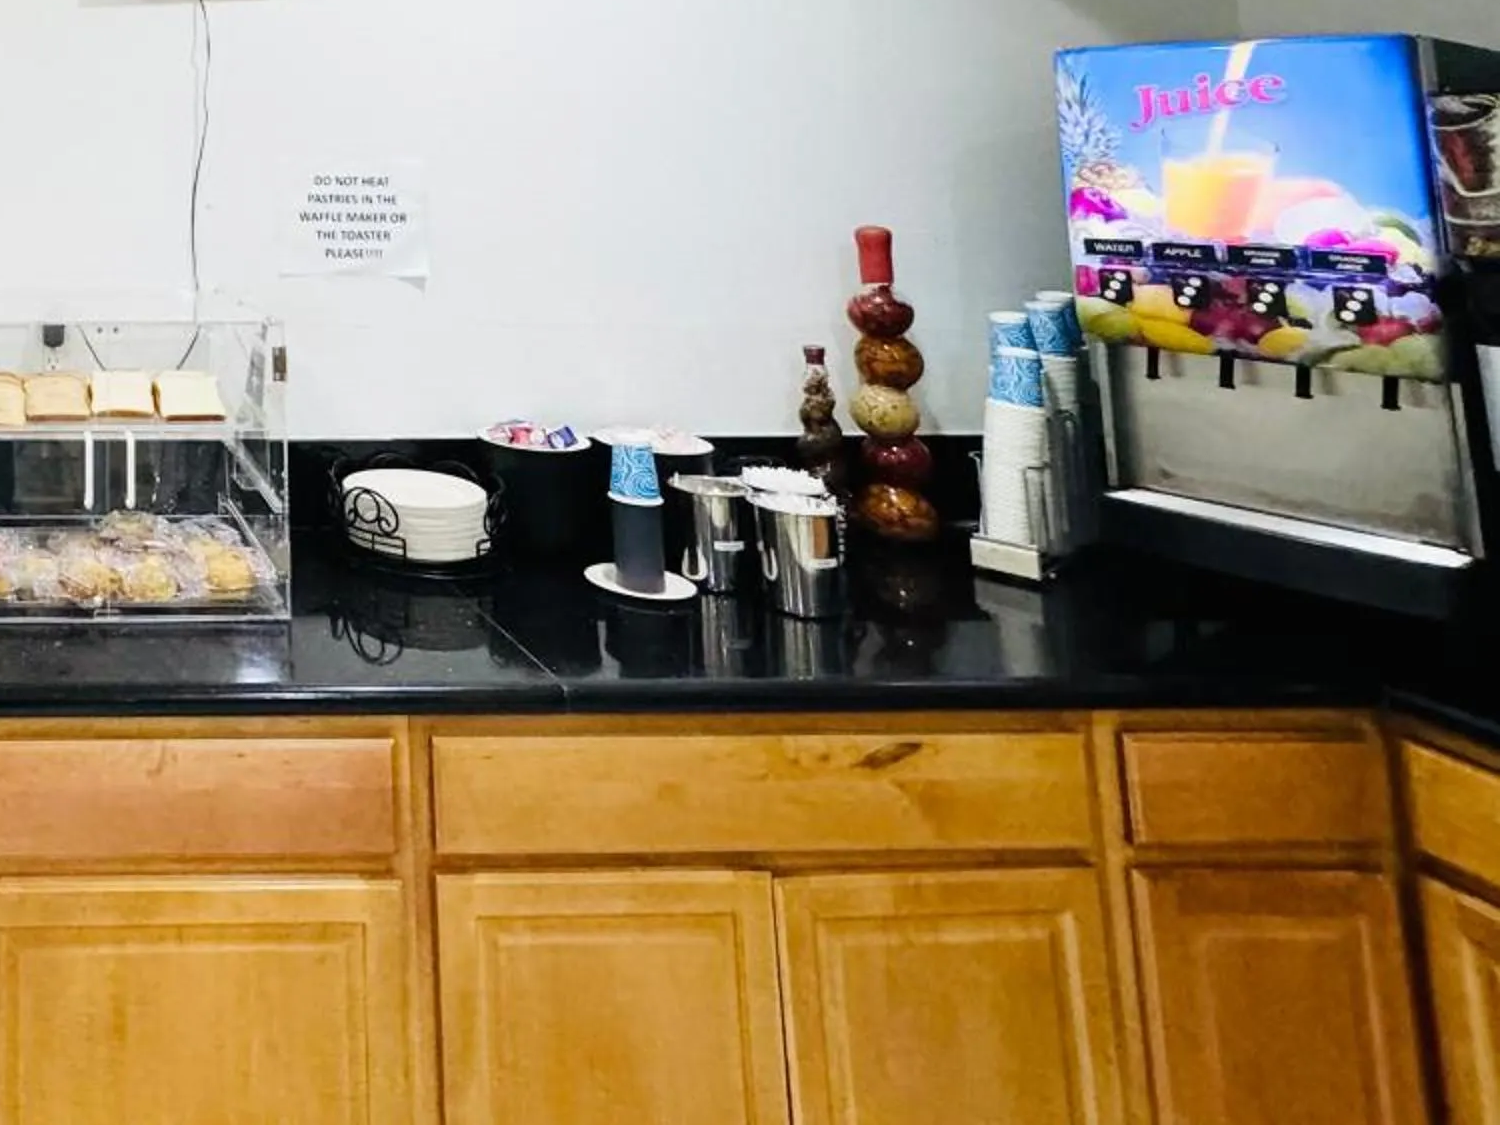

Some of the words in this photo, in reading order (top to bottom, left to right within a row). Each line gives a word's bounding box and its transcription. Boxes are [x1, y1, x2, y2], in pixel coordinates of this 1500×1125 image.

[1129, 74, 1285, 132] Juice
[314, 175, 332, 186] DO
[335, 176, 358, 186] NOT
[361, 176, 389, 187] HEAT
[308, 194, 358, 204] PASTRIES
[362, 194, 373, 204] IN
[377, 194, 396, 205] THE
[299, 211, 342, 223] WAFFLE
[346, 212, 387, 223] MAKER
[390, 213, 407, 224] OR
[316, 230, 337, 241] THE
[341, 230, 391, 241] TOASTER
[1094, 241, 1135, 252] WATER
[1163, 247, 1203, 258] APPLE
